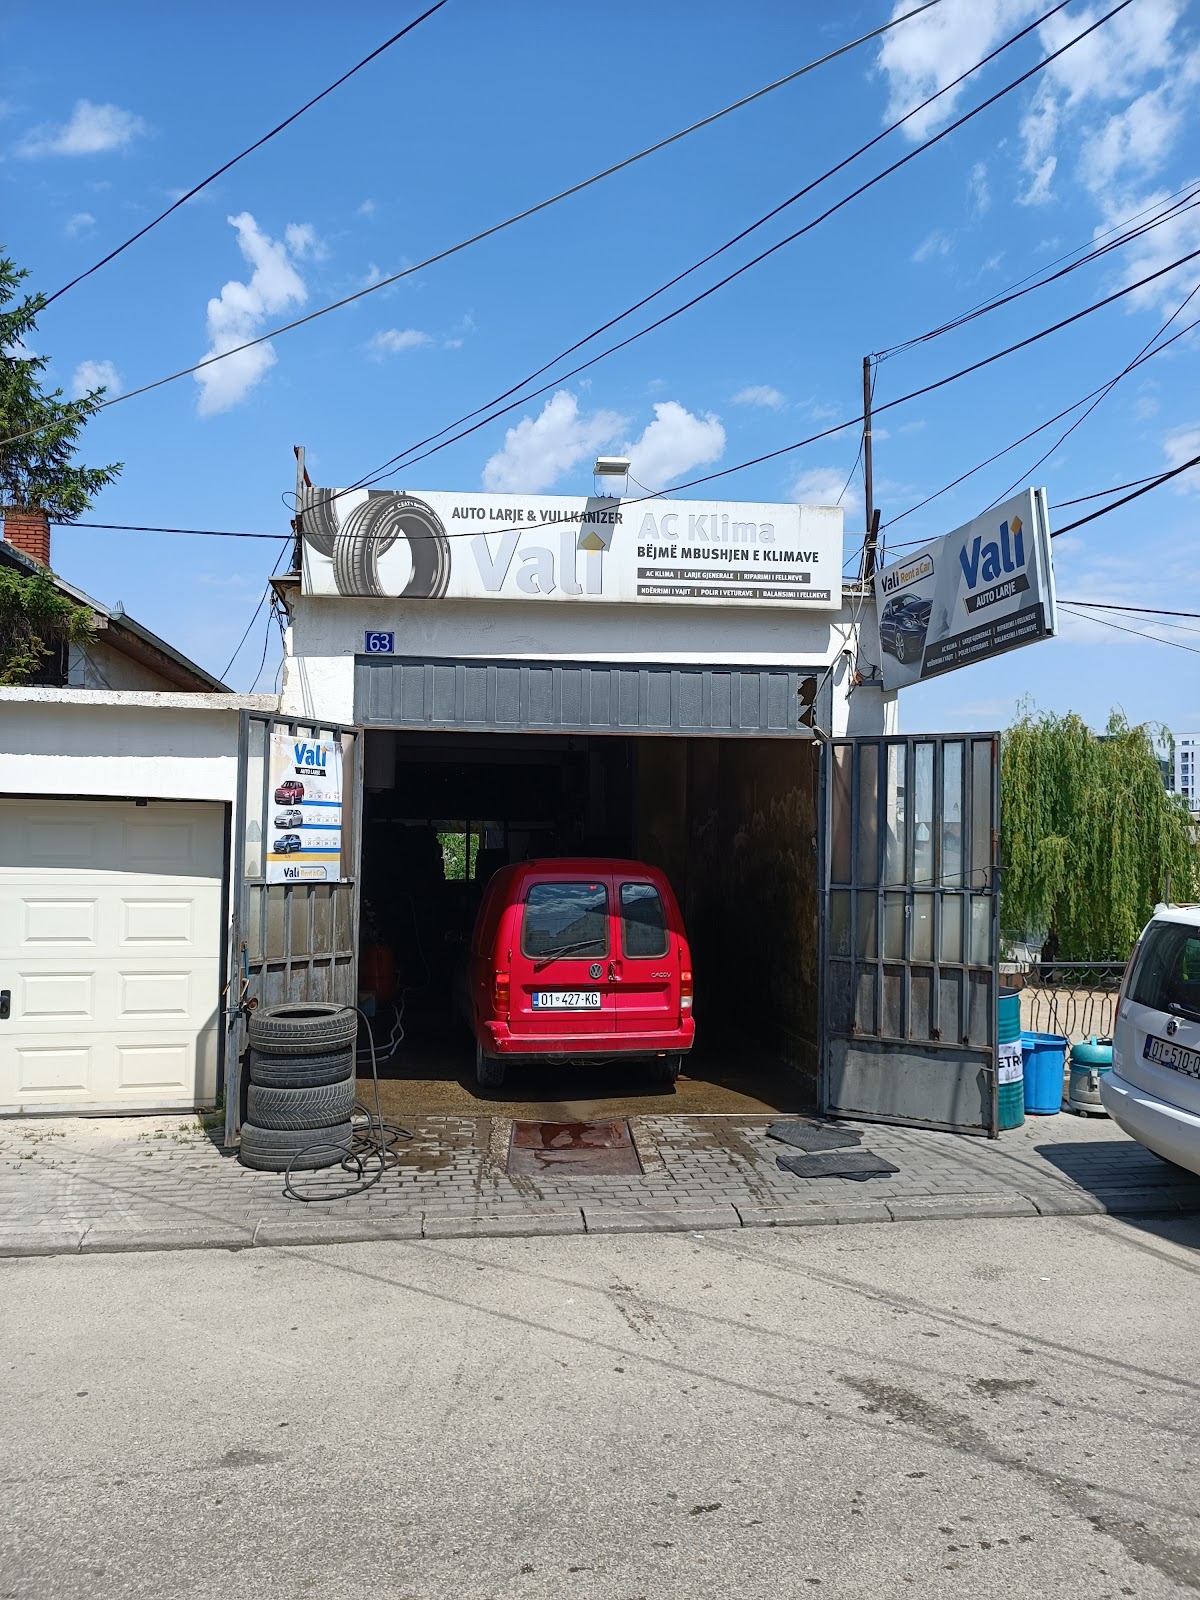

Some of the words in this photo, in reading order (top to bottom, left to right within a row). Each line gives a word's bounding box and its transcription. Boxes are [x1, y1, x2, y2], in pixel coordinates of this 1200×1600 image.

[452, 507, 486, 520] AUTO
[490, 508, 524, 523] LARJE
[527, 510, 536, 522] &
[540, 510, 623, 524] VULLKANIZER
[638, 513, 680, 540] AC
[688, 514, 775, 543] Klima
[470, 531, 605, 595] Vali
[638, 544, 677, 560] BËJMË
[681, 547, 748, 562] MBUSHJEN
[754, 550, 760, 560] E
[764, 550, 819, 562] KLIMAVE
[960, 516, 1025, 590] Vali
[881, 567, 899, 592] Vali
[900, 567, 915, 583] Rent
[919, 561, 930, 573] Car
[976, 592, 994, 608] AUTO
[996, 581, 1016, 598] LARJE
[370, 634, 390, 651] 63
[294, 743, 326, 766] Vali
[284, 867, 299, 877] Vali
[541, 993, 553, 1005] 01
[562, 993, 598, 1006] 427-KG
[1152, 1041, 1164, 1060] 01
